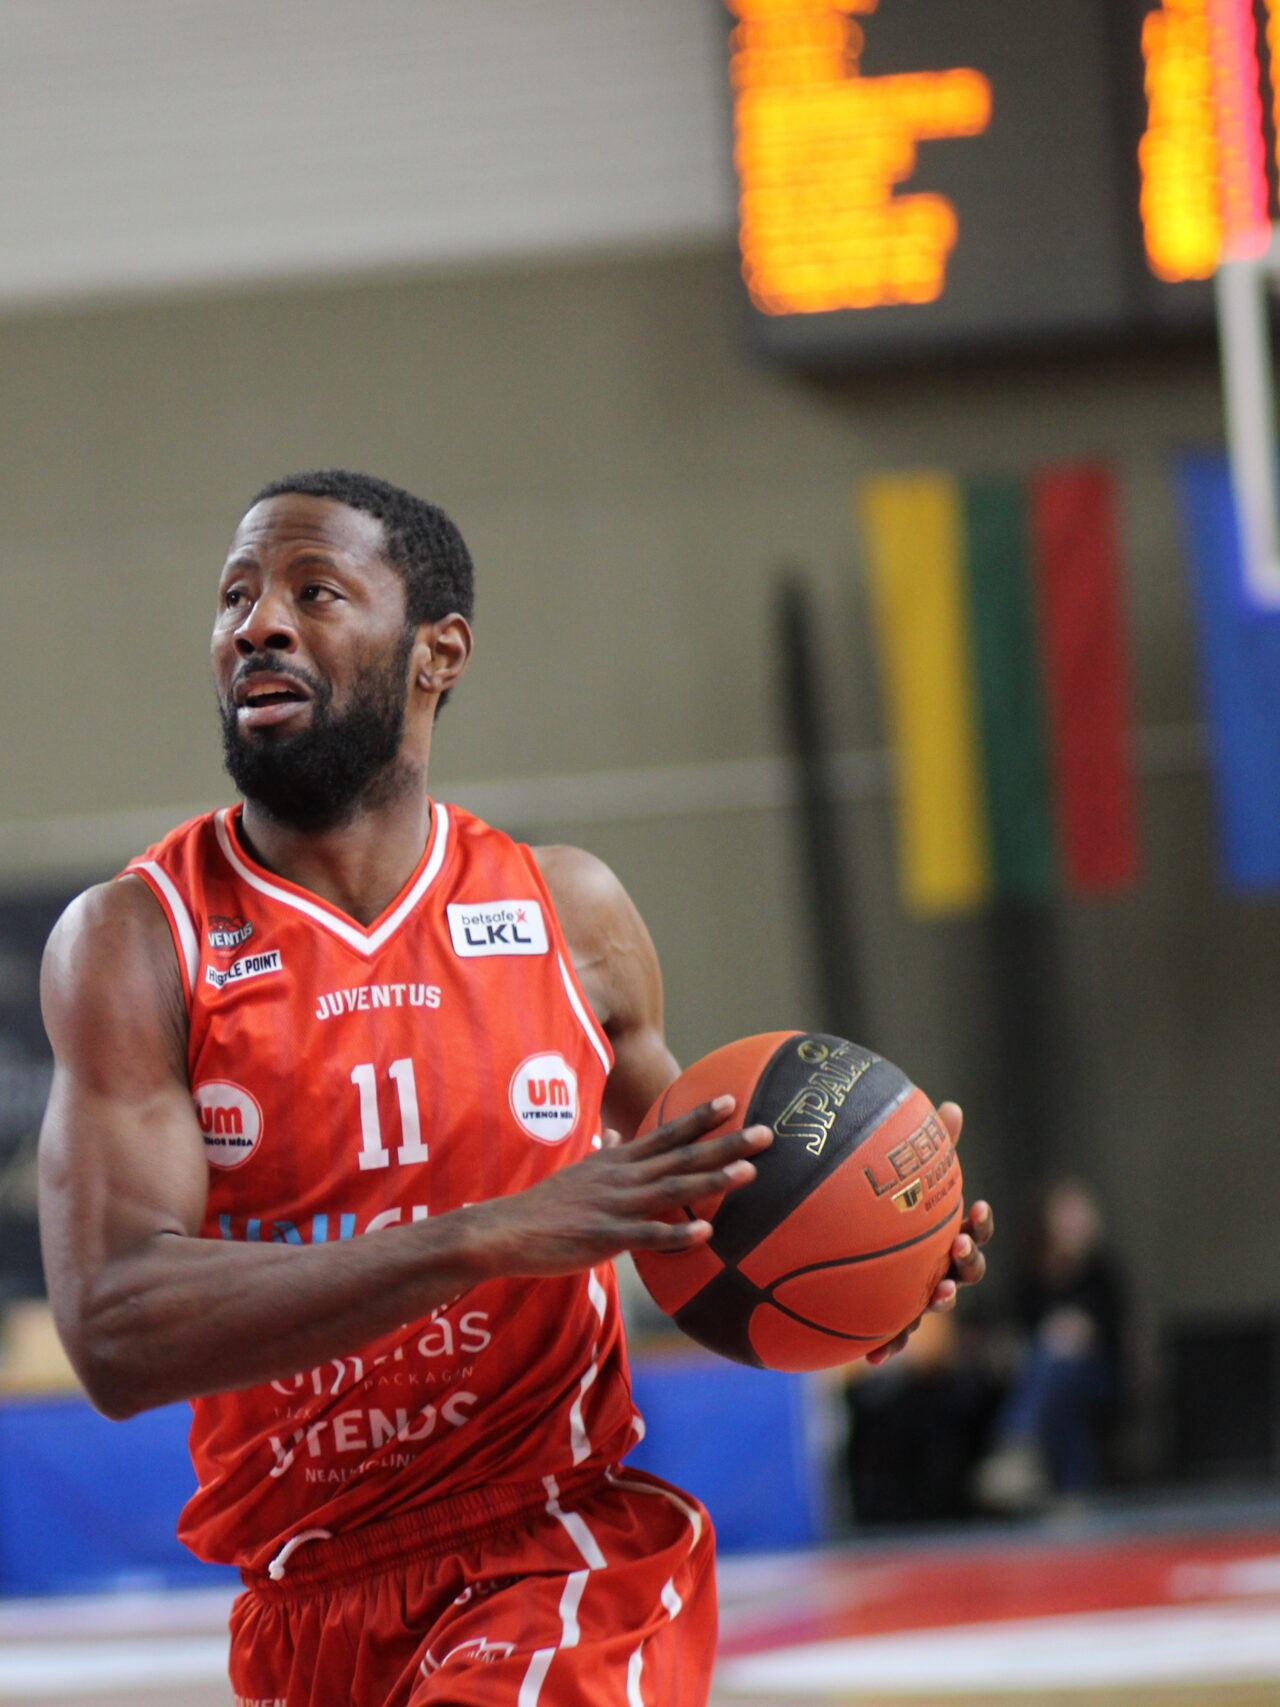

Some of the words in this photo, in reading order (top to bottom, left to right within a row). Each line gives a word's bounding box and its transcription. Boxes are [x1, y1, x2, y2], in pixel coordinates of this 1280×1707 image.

[461, 910, 515, 926] betsafe
[208, 922, 254, 948] VENTUS
[464, 923, 532, 946] LKL
[245, 953, 278, 975] POINT
[315, 984, 442, 1020] JUVENTUS
[350, 1057, 430, 1171] 11
